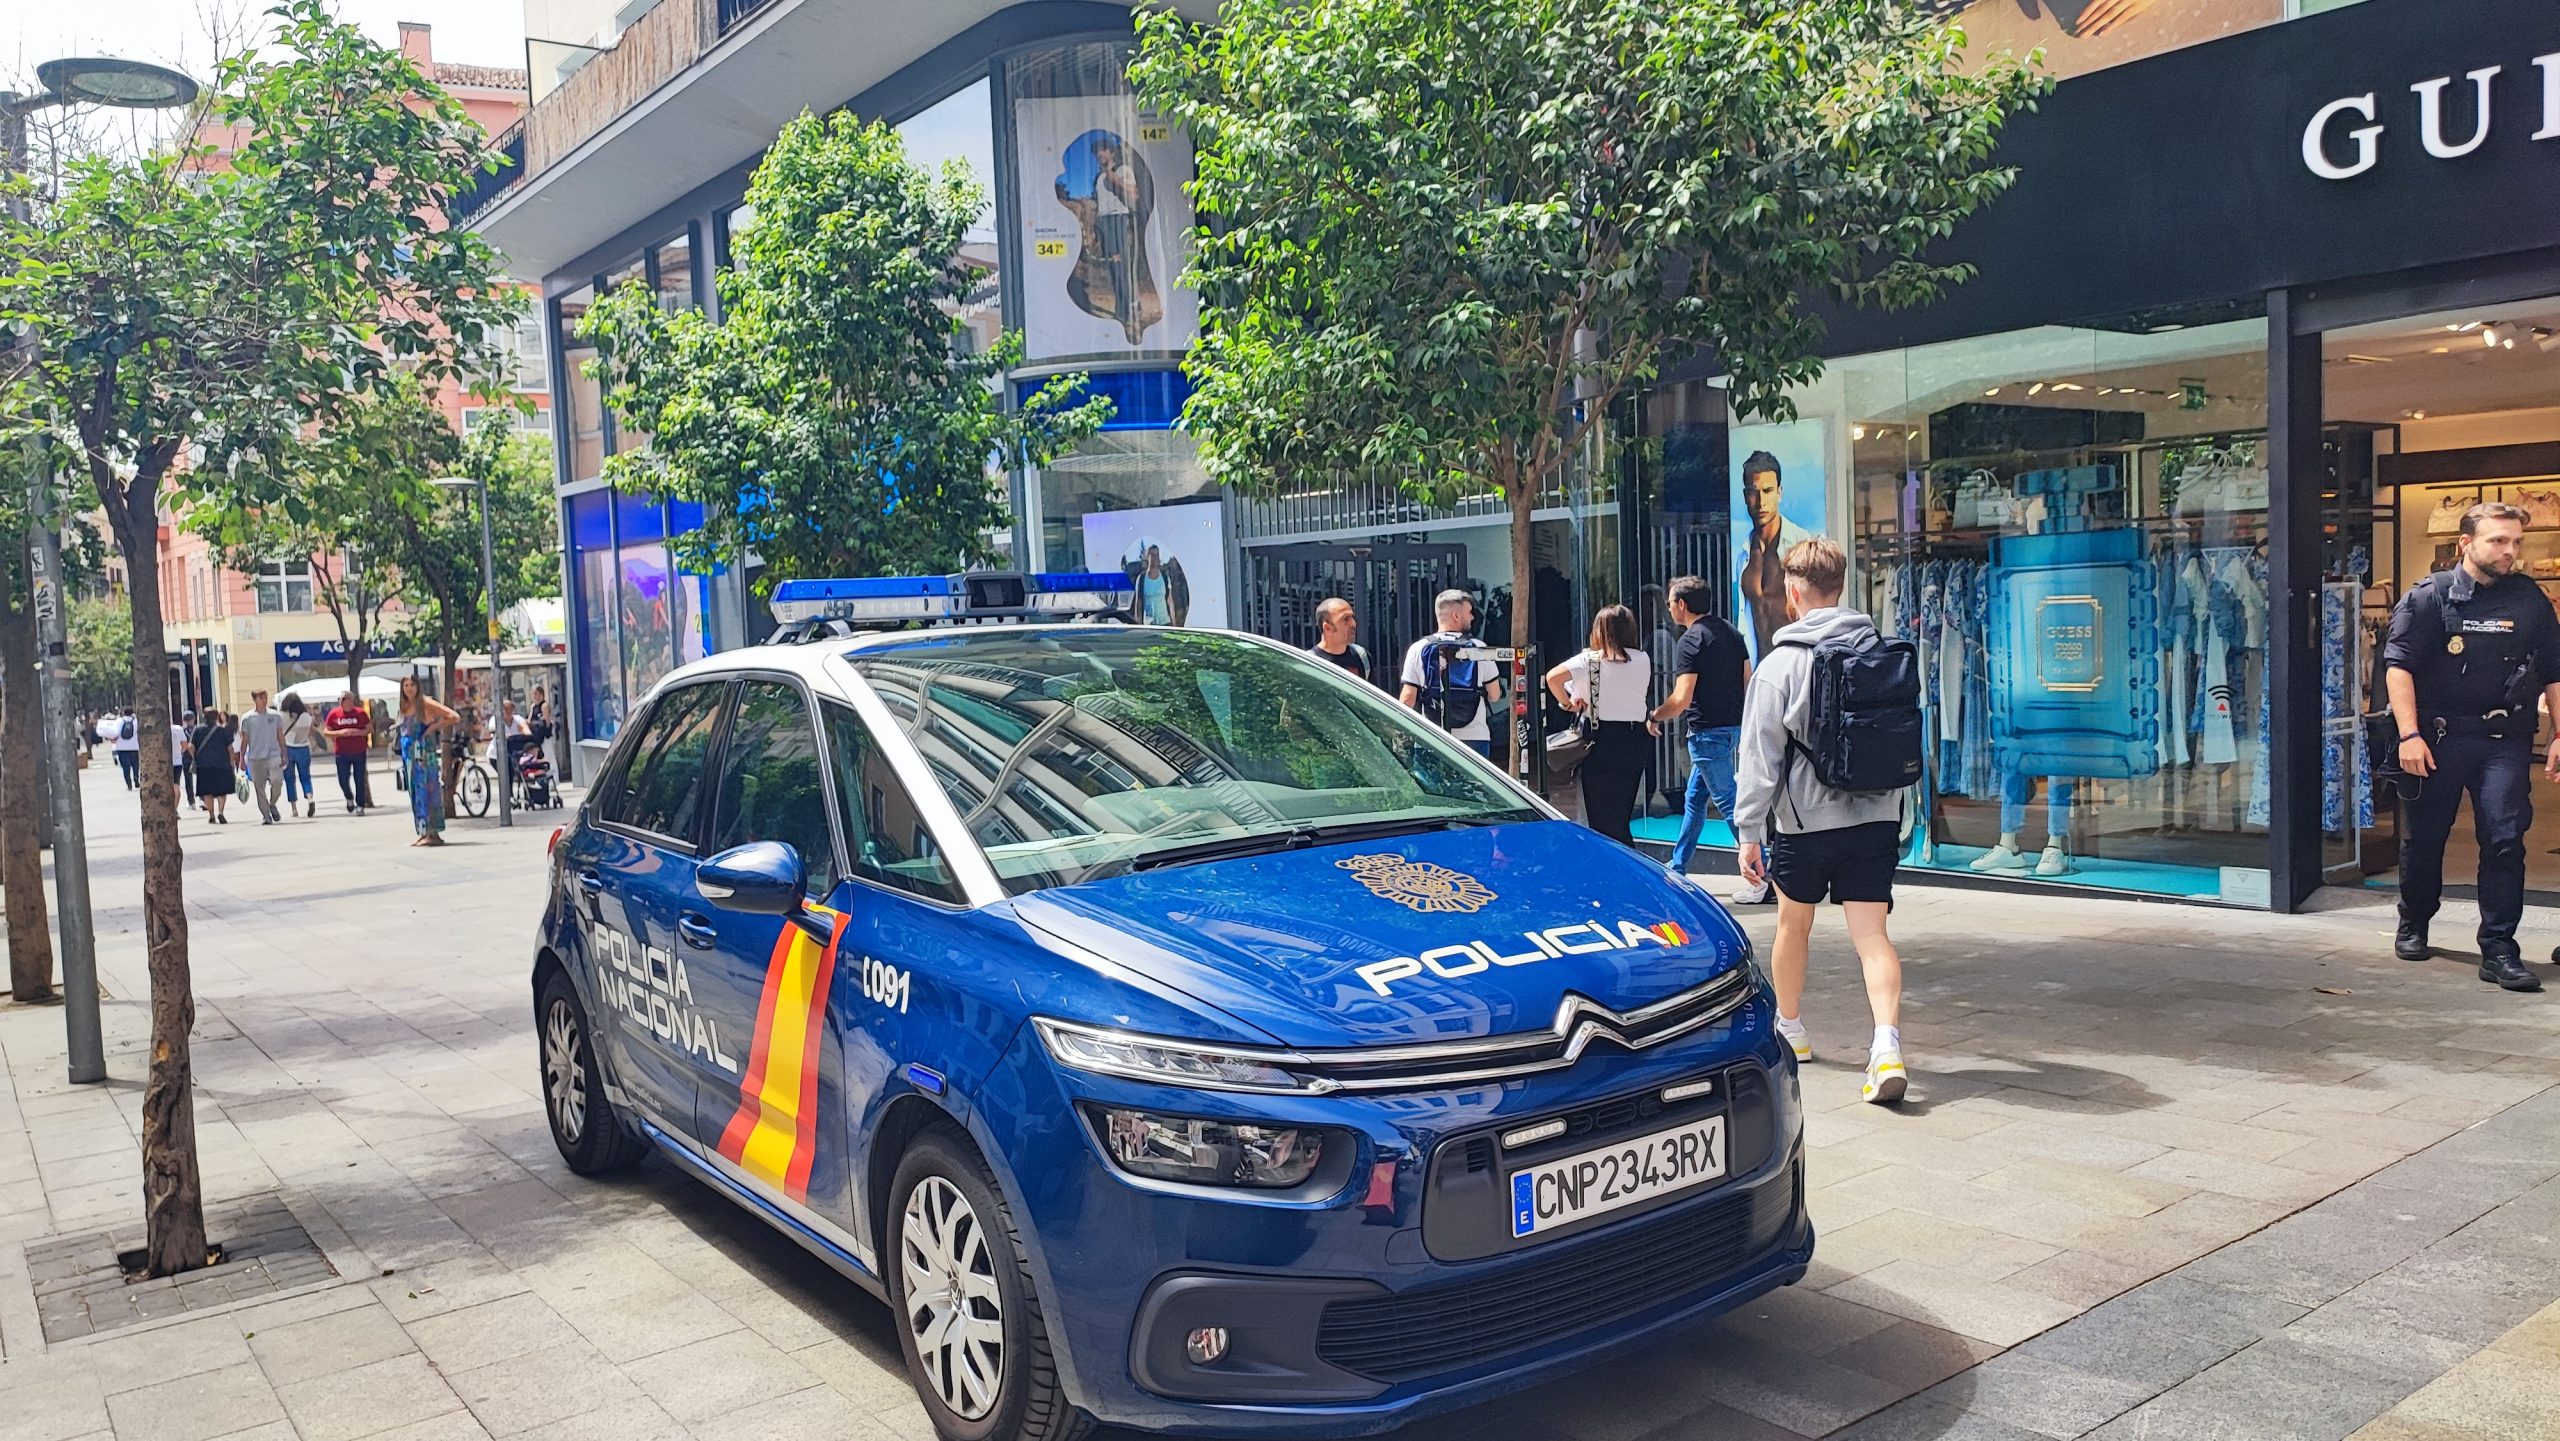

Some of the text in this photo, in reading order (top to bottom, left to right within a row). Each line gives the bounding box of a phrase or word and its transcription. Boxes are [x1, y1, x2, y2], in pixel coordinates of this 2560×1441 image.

[321, 640, 395, 654] AGHA
[2047, 626, 2093, 638] GUESS
[595, 924, 695, 1006] POLICÍA
[872, 960, 911, 1014] 091
[599, 964, 738, 1074] NACIONAL
[1520, 1125, 1717, 1225] E CNP2343RX
